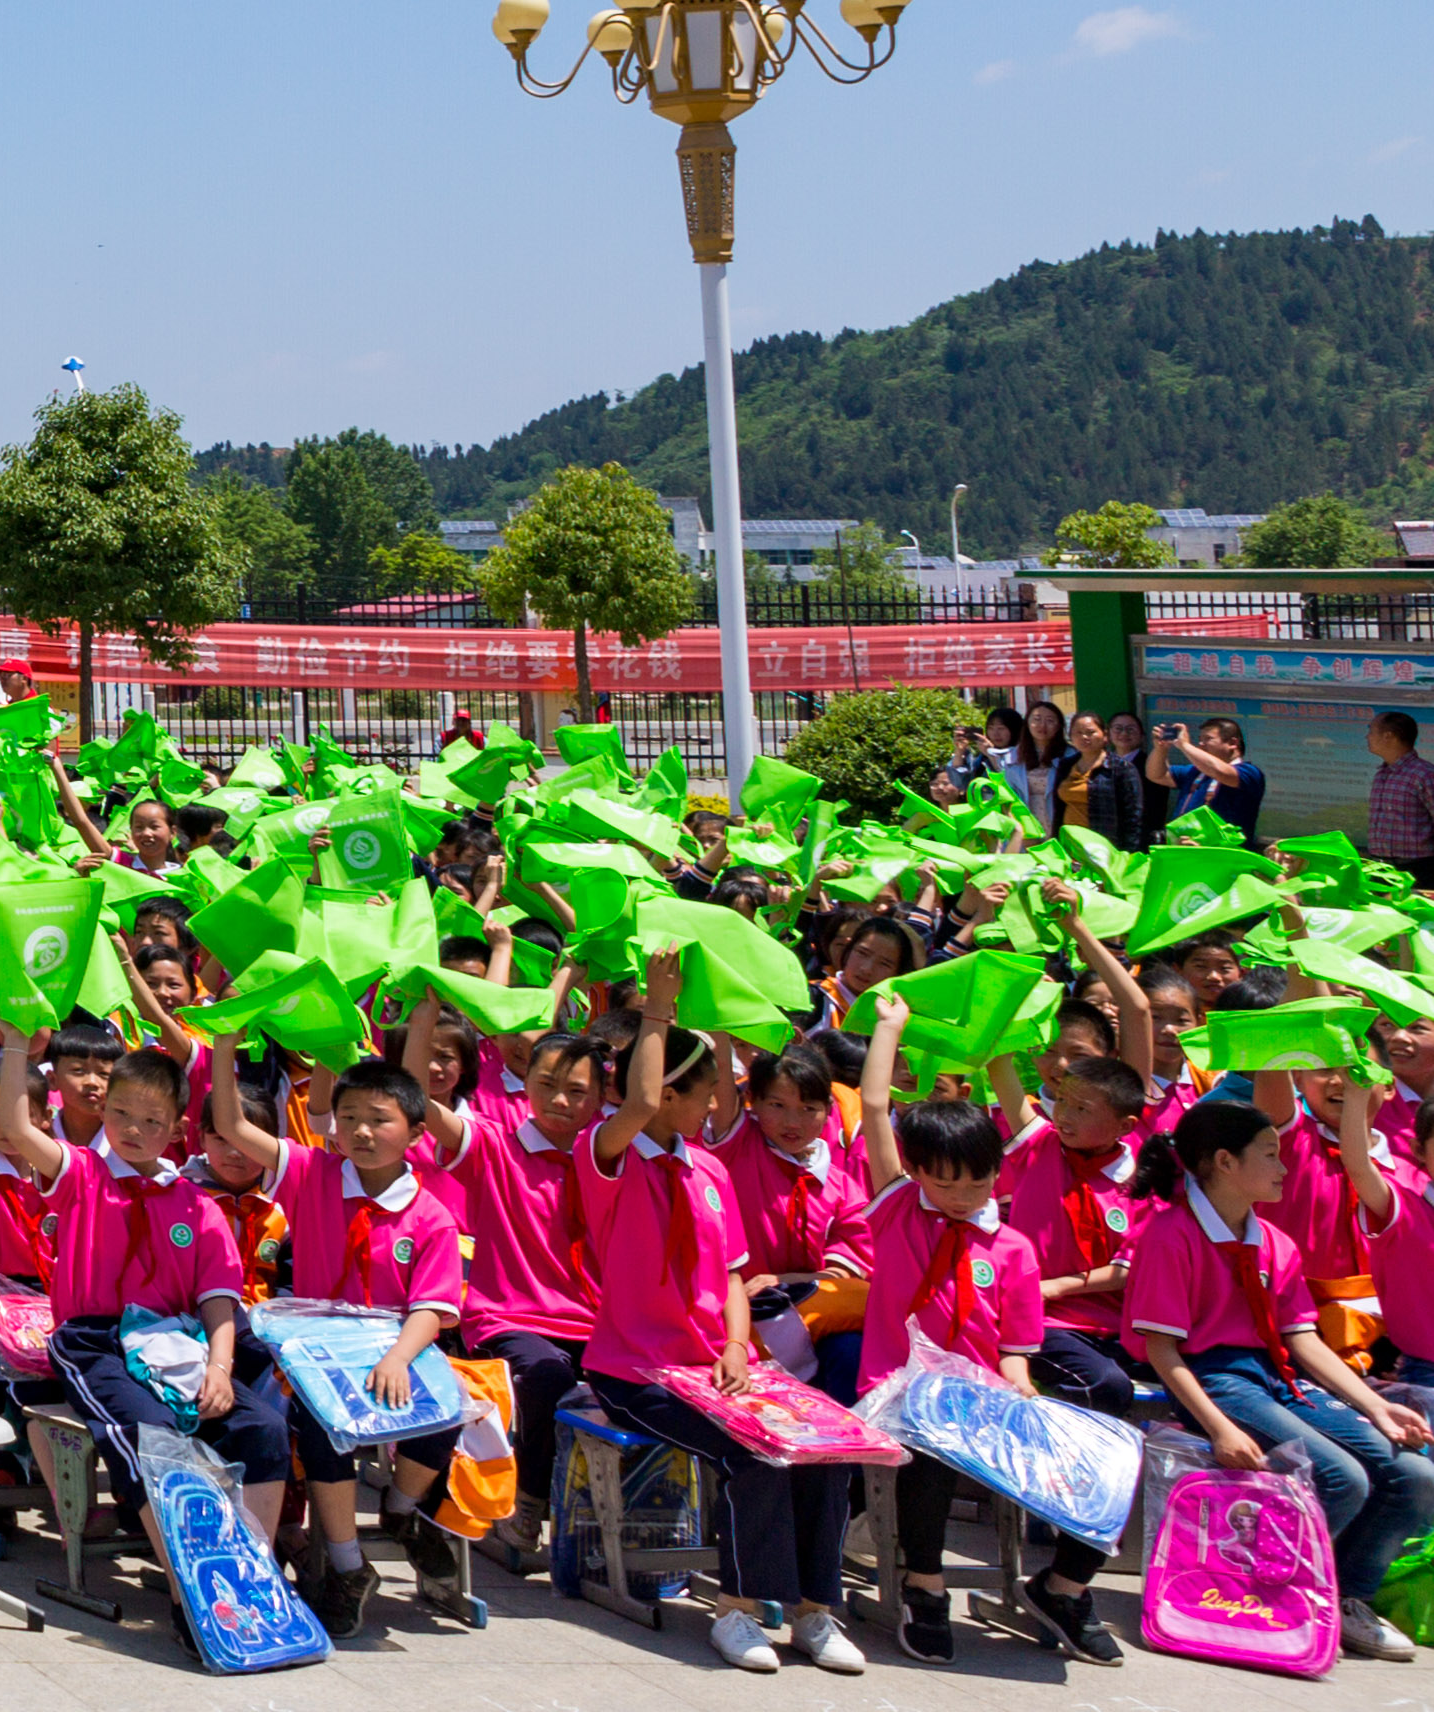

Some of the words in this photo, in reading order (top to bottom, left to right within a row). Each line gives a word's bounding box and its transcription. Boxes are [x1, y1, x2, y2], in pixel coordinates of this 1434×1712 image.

[66, 632, 221, 674] 拒绝食
[255, 636, 410, 677] 勤俭节约
[757, 639, 871, 679] 立自强
[904, 633, 1073, 676] 拒绝家长
[1173, 653, 1276, 677] 超越自我
[1302, 656, 1416, 682] 争创辉煌
